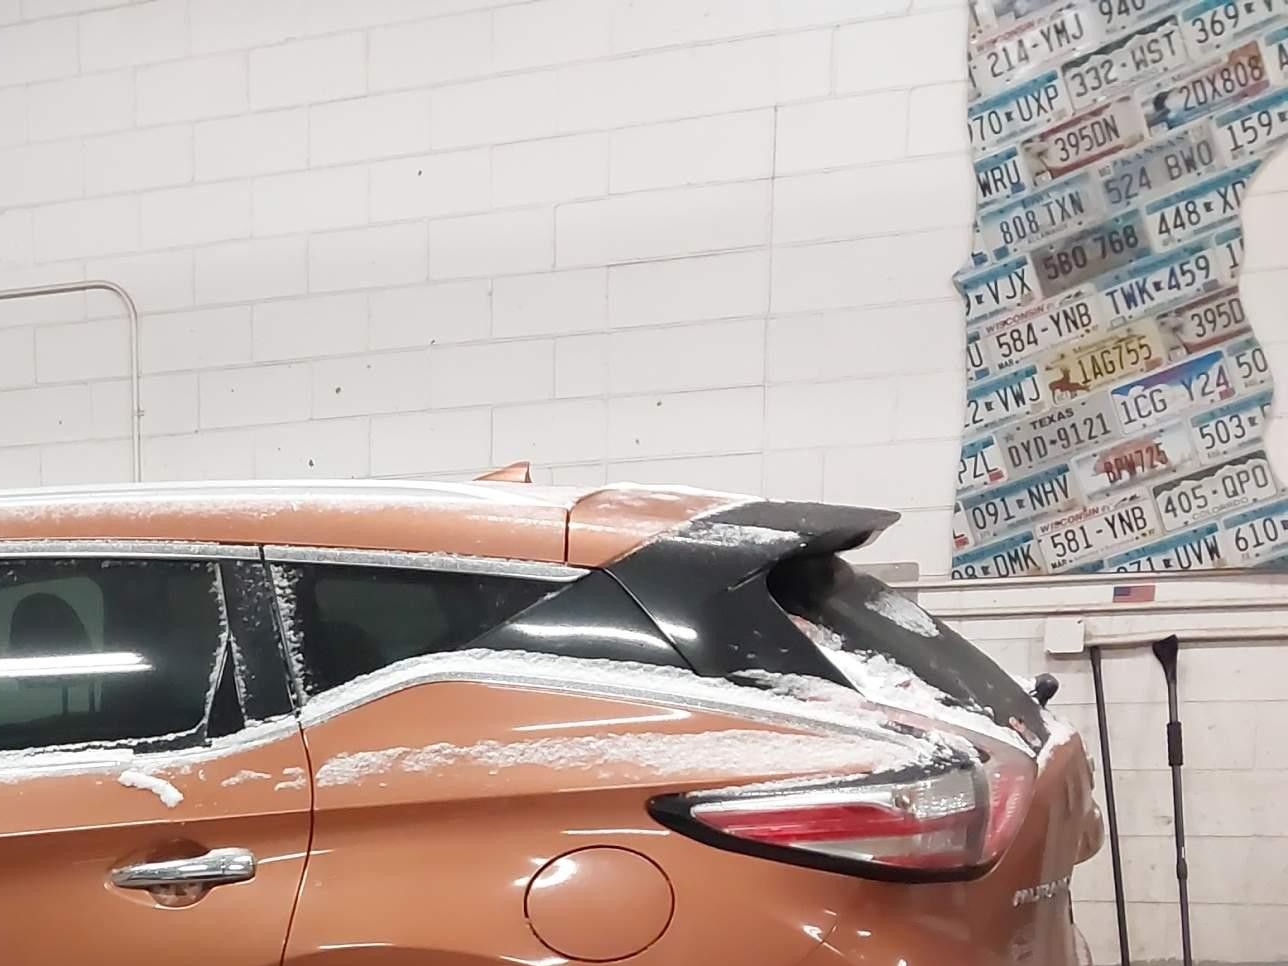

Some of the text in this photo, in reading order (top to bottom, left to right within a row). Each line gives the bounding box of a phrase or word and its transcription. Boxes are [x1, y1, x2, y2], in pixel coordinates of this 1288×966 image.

[1192, 2, 1239, 44] 369
[1226, 109, 1274, 152] 159
[976, 159, 1022, 198] WRU
[1103, 166, 1152, 205] 524
[999, 209, 1040, 245] 808
[995, 301, 1092, 358] 584-YNB
[1030, 407, 1075, 431] TEXAS
[1198, 413, 1247, 451] 503
[1050, 505, 1148, 558] 581-YNB
[1234, 517, 1279, 552] 610
